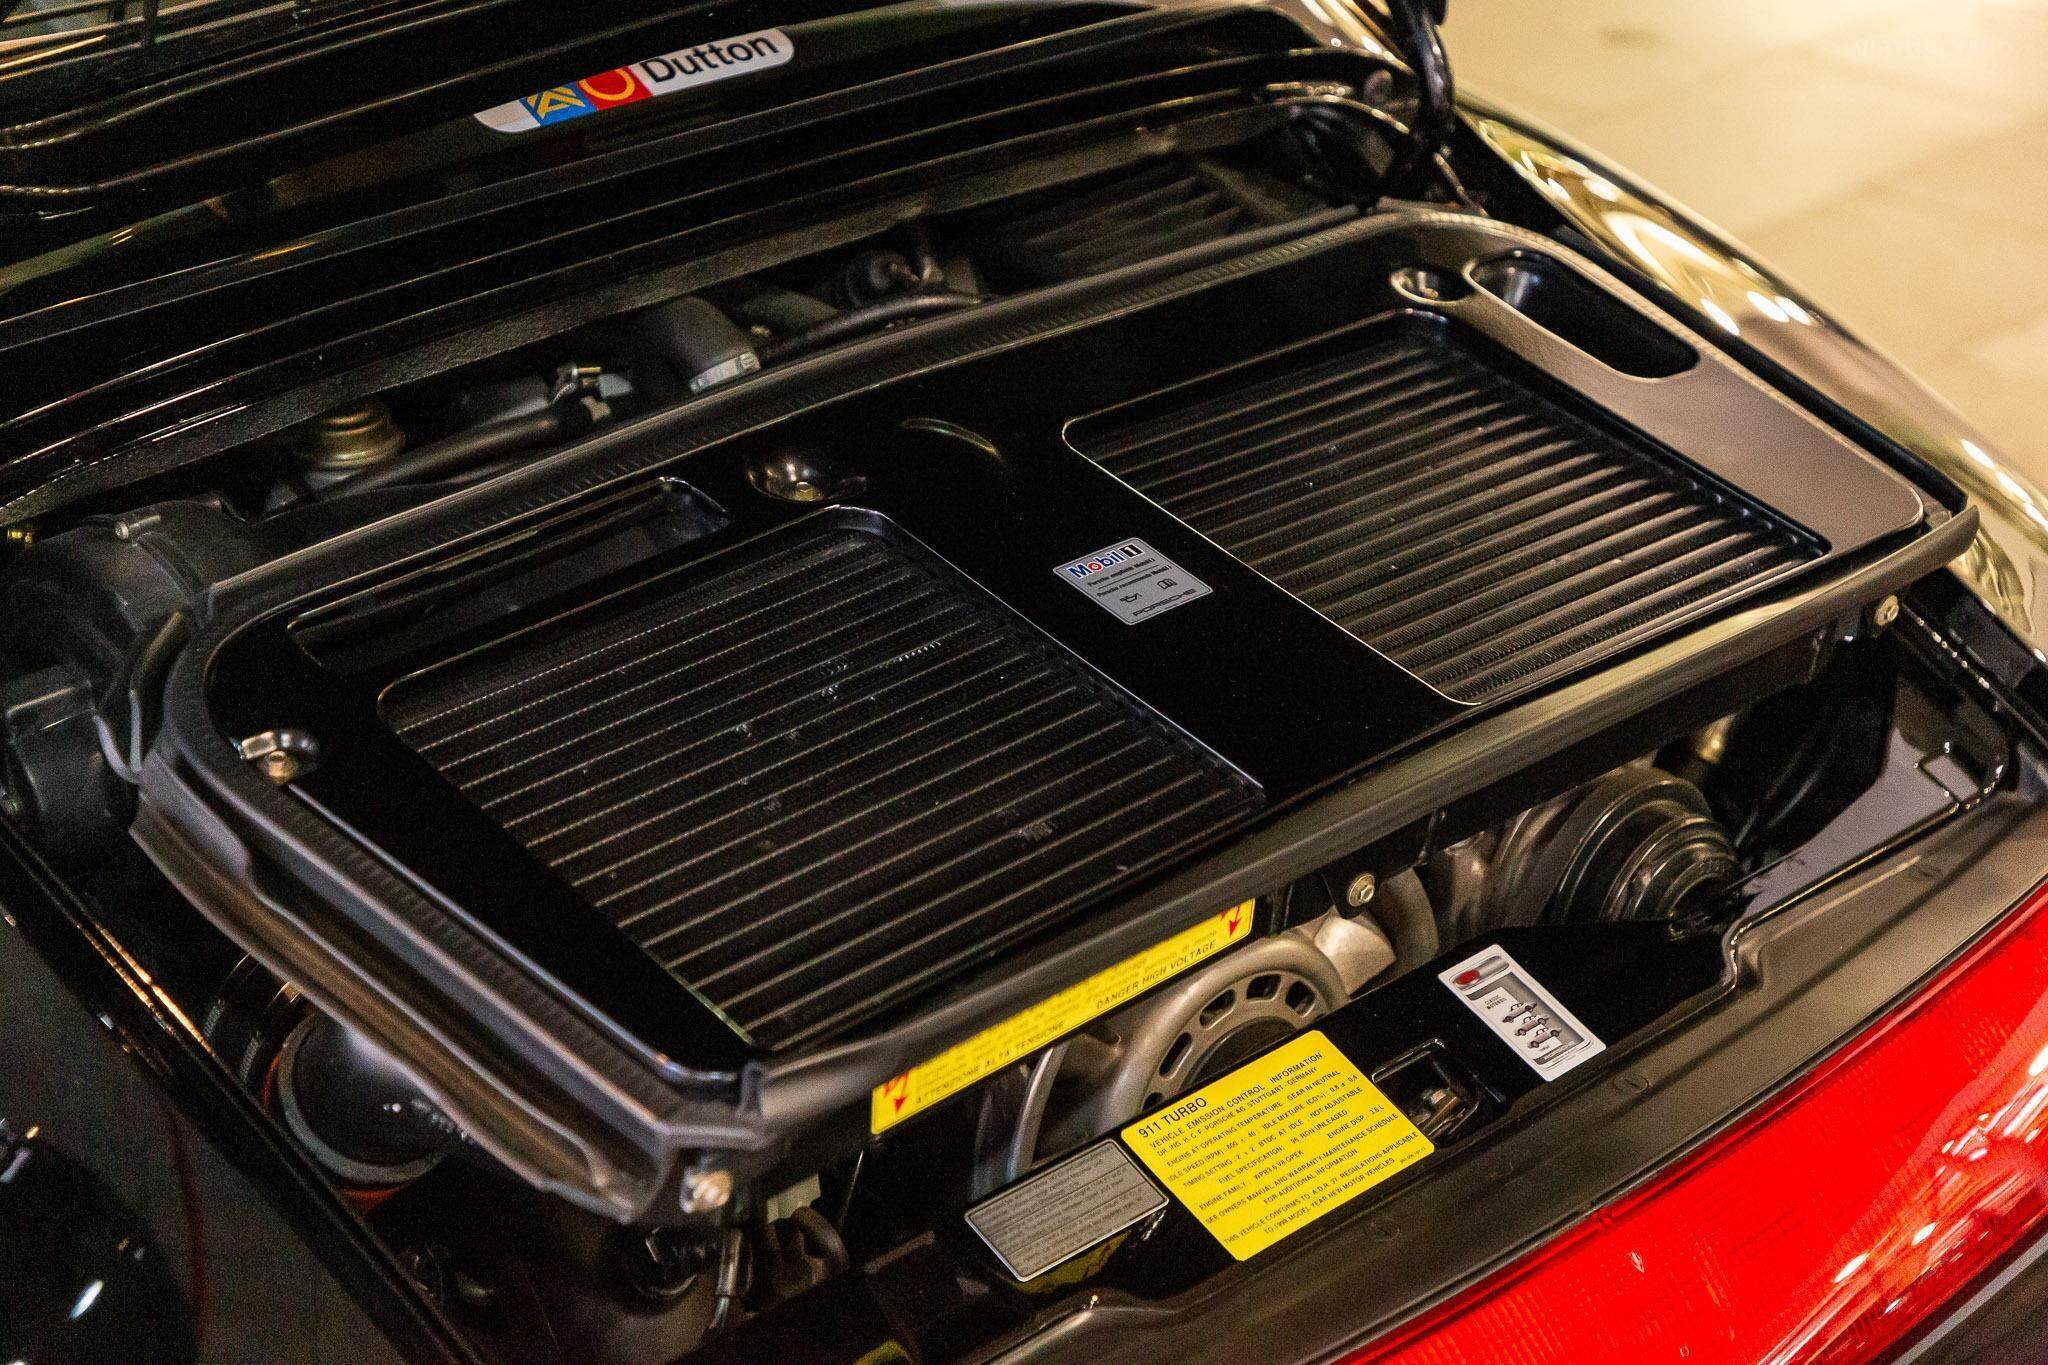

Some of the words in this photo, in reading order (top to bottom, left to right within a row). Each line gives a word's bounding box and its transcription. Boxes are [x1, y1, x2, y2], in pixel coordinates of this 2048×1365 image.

[641, 35, 778, 83] Dutton
[1067, 550, 1125, 577] Mobil
[1131, 588, 1197, 616] PORSCHE
[1097, 979, 1139, 1009] DANGER
[1142, 965, 1166, 985] HIGH
[1170, 939, 1215, 970] VOLTAGE
[1137, 1121, 1161, 1138] 911
[1159, 1096, 1209, 1126] TURBO
[1148, 1127, 1185, 1149] VEHICLE
[1184, 1105, 1225, 1129] EMISSION
[1224, 1083, 1265, 1107] CONTROL
[1268, 1052, 1324, 1083] INFORMATION
[1165, 1151, 1191, 1167] ENGINE
[1198, 1126, 1237, 1148] OPERATING
[1235, 1101, 1283, 1129] TEMPERATURE
[1286, 1088, 1306, 1101] GEAR
[1310, 1069, 1341, 1087] NEUTRAL
[1202, 1111, 1235, 1130] PORSCHE
[1245, 1084, 1284, 1107] STUTTGART
[1285, 1066, 1318, 1085] GERMANY
[1287, 1118, 1304, 1130] IDLE
[1308, 1107, 1324, 1118] NOT
[1322, 1086, 1363, 1110] ADJUSTABLE
[1166, 1170, 1184, 1181] IDLE
[1182, 1158, 1205, 1173] SPEED
[1261, 1118, 1278, 1130] IDLE
[1275, 1103, 1305, 1121] MIXTURE
[1198, 1194, 1224, 1210] ENGINE
[1326, 1123, 1351, 1138] ENGINE
[1217, 1172, 1235, 1184] FUEL
[1313, 1109, 1348, 1130] UNLEADED
[1245, 1183, 1274, 1201] MANUAL
[1272, 1175, 1288, 1186] AND
[1364, 1112, 1399, 1133] SCHEDULE
[1380, 1130, 1418, 1154] APPLICABLE
[1262, 1193, 1279, 1205] FOR
[1276, 1172, 1316, 1196] ADDITIONAL
[1340, 1173, 1365, 1189] MOTOR
[1363, 1156, 1395, 1176] VEHICLES
